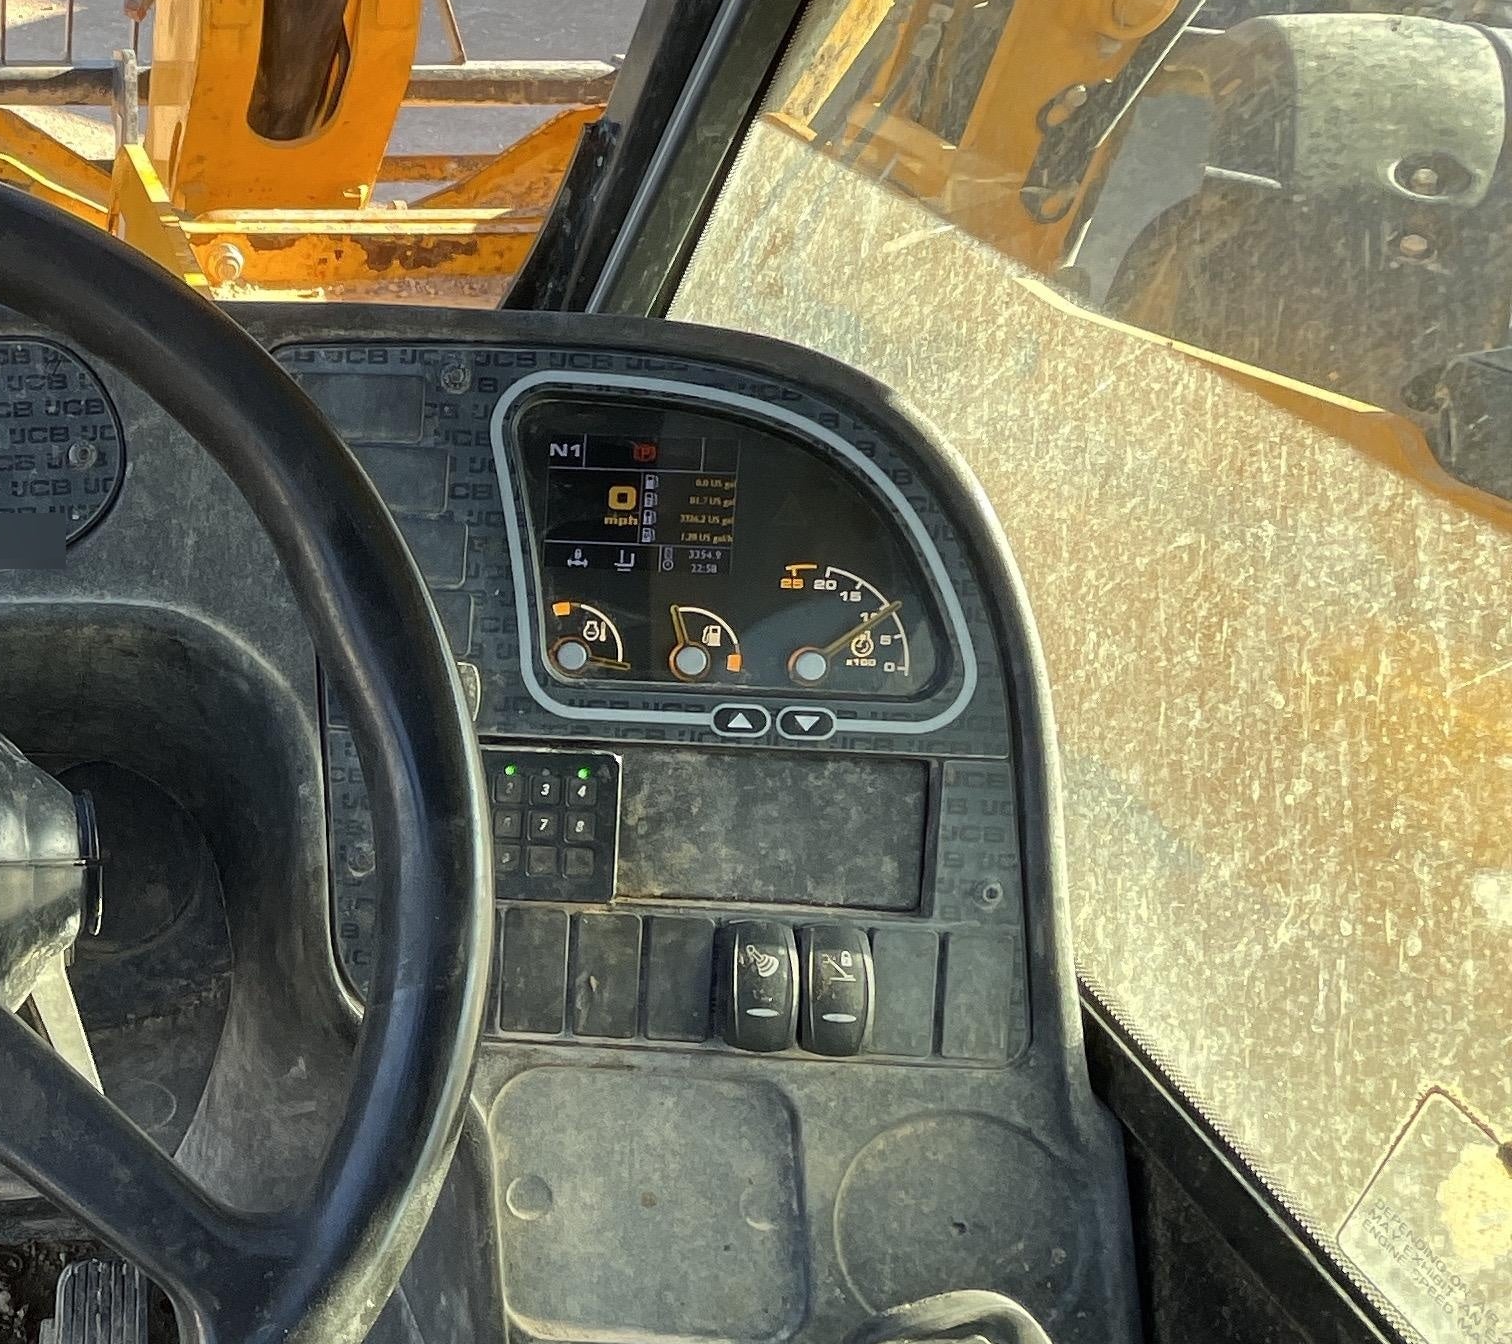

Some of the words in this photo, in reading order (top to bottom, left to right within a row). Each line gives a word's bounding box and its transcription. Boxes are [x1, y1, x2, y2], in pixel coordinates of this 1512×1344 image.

[8, 425, 70, 445] JCB
[549, 442, 582, 458] N1
[608, 485, 637, 511] 0
[604, 515, 638, 526] mph
[691, 563, 719, 574] 22:58
[813, 579, 838, 591] 20
[839, 591, 862, 602] 15
[883, 662, 896, 672] 0
[540, 783, 551, 796] 3
[577, 785, 588, 798] 4
[539, 818, 550, 831] 7
[575, 820, 586, 833] 8
[1361, 1218, 1408, 1265] ENGINE
